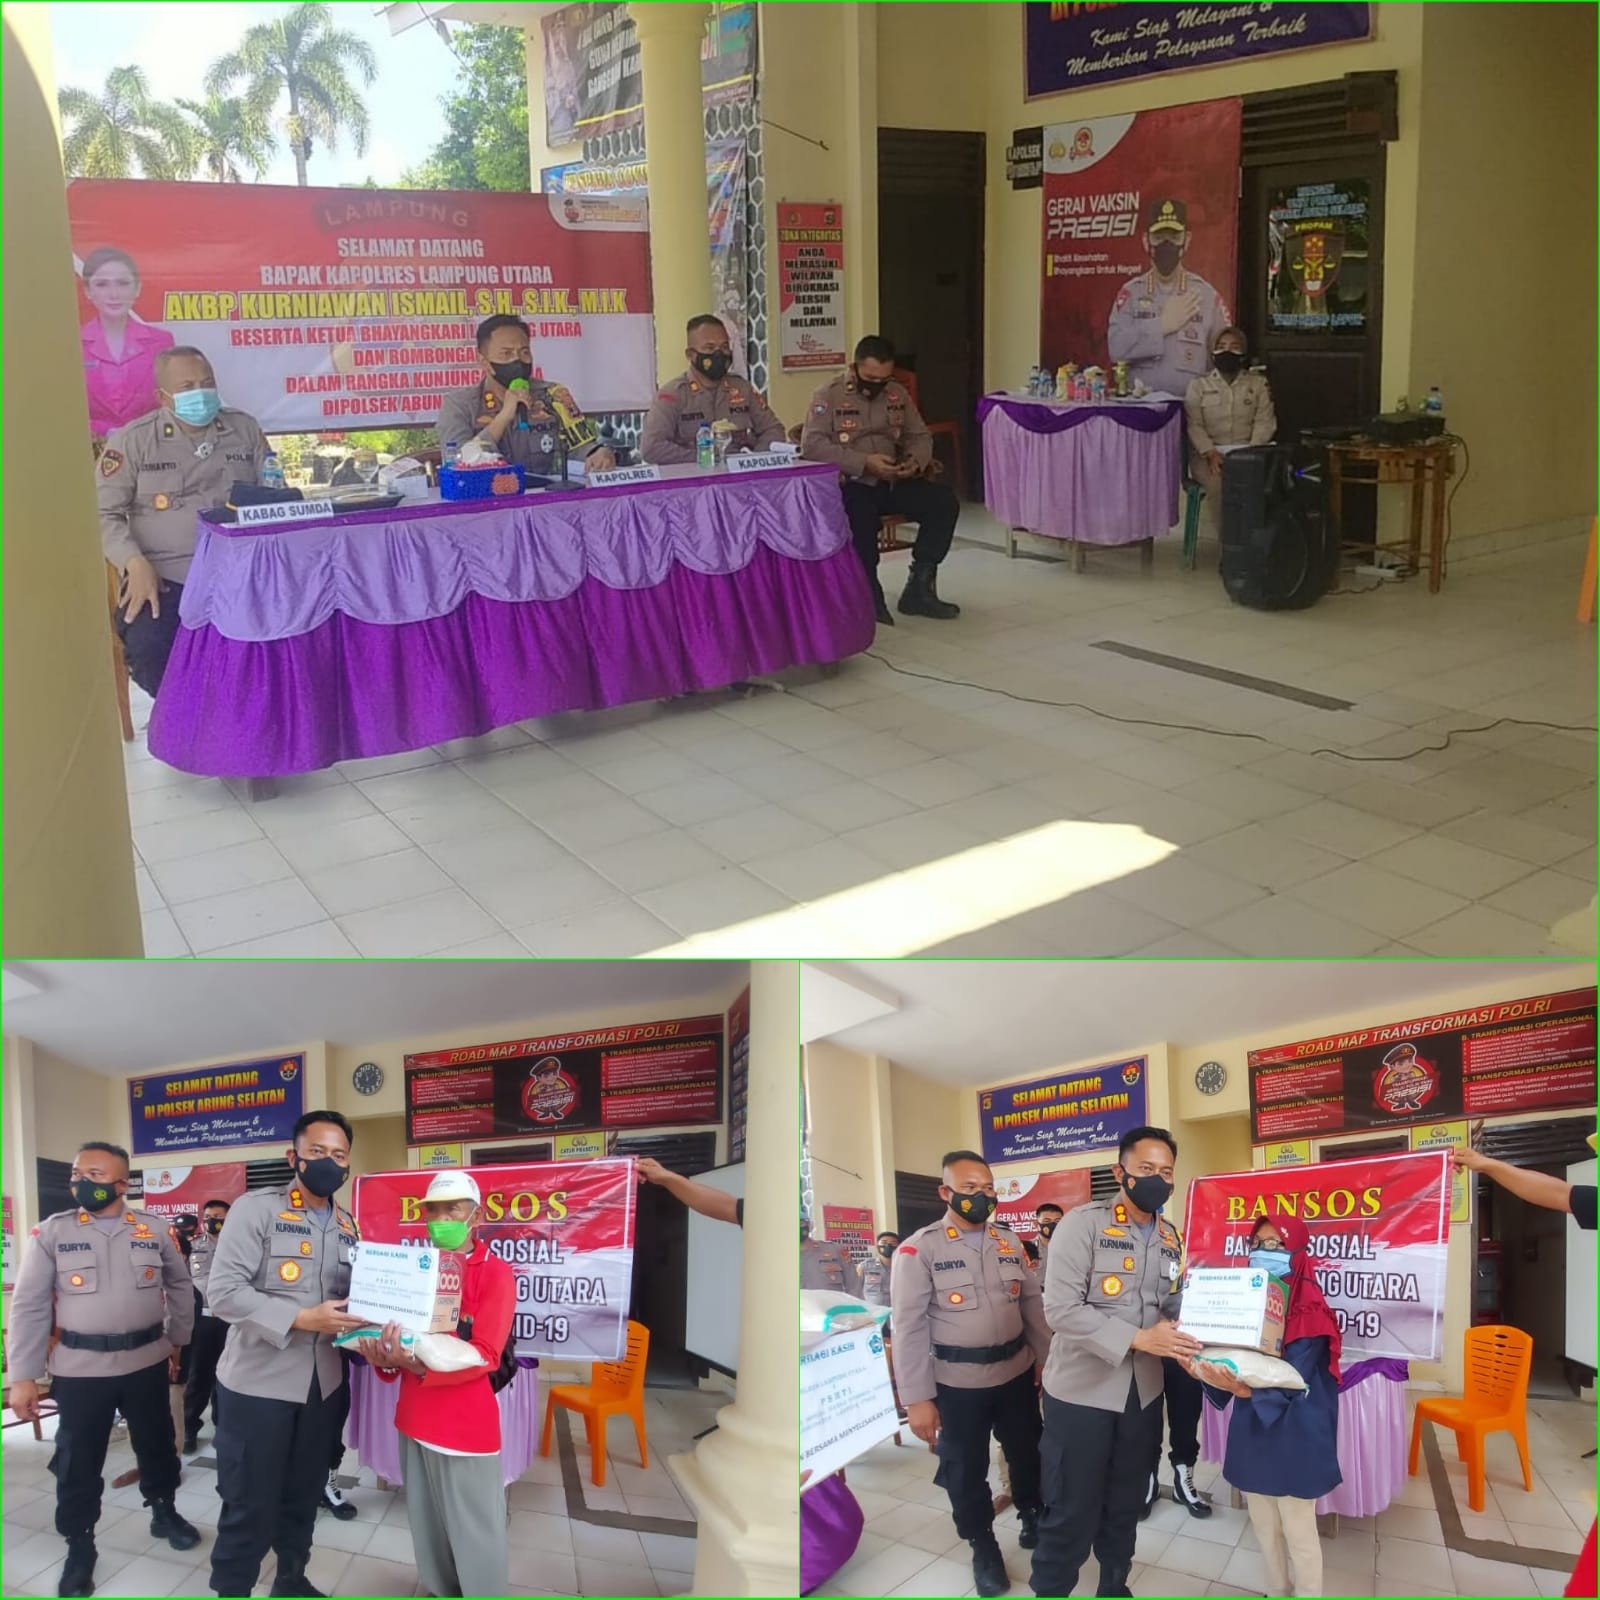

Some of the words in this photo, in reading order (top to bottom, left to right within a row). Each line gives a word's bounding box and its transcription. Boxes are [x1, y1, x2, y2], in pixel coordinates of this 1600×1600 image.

[1090, 27, 1128, 49] Kami
[1134, 19, 1169, 39] Siap
[1176, 3, 1253, 29] Melayani
[1066, 50, 1148, 76] Memberikan
[1153, 33, 1236, 58] Pelayanan
[1243, 13, 1307, 42] Terbaik
[325, 200, 469, 228] LAMPUNG
[1047, 197, 1085, 216] GERAI
[1089, 192, 1140, 212] VAKSIN
[1047, 213, 1138, 240] PRESISI
[1295, 221, 1334, 233] PROPAM
[338, 238, 415, 258] SELAMAT
[420, 239, 484, 257] DATANG
[798, 248, 825, 257] ANDA
[785, 259, 838, 269] MEMASUKI
[261, 266, 321, 285] BAPAK
[327, 266, 415, 285] KAPOLRES
[420, 266, 498, 284] LAMPUNG
[503, 266, 552, 284] UTARA
[790, 271, 834, 280] WILAYAH
[785, 282, 839, 293] BIROKRASI
[165, 292, 237, 321] AKBP
[240, 291, 386, 320] KURNIAWAN
[391, 290, 472, 317] ISMAIL,
[795, 294, 831, 304] BERSIH
[803, 306, 823, 316] DAN
[790, 317, 837, 328] MELAYANI
[231, 327, 303, 346] BESERTA
[307, 327, 355, 344] KETUA
[361, 323, 466, 343] BHAYANGKARI
[540, 322, 581, 337] UTARA
[354, 349, 384, 366] DAN
[389, 346, 478, 365] ROMBONGA
[286, 375, 341, 393] DALAM
[346, 372, 409, 391] RANGKA
[413, 370, 487, 388] KUNJUNGA
[323, 397, 398, 415] DIPOLSEK
[402, 394, 442, 412] ABUN
[738, 455, 791, 469] KAPOLSEK
[596, 469, 655, 483] KAPOLRES
[242, 504, 285, 522] KABAG
[288, 501, 332, 517] SUMDA
[1295, 1039, 1335, 1057] ROAD
[1336, 1032, 1369, 1049] MAP
[1372, 1010, 1495, 1042] TRANSFORMASI
[1498, 999, 1553, 1020] POLRI
[450, 1049, 486, 1062] ROAD
[488, 1044, 518, 1058] MAP
[521, 1030, 631, 1053] TRANSFORMASI
[634, 1023, 680, 1039] POLRI
[166, 1077, 213, 1097] SELAMAT
[214, 1070, 259, 1089] DATANG
[1012, 1084, 1058, 1107] SELAMAT
[1059, 1076, 1102, 1097] DATANG
[1383, 1083, 1432, 1102] PRESISI
[144, 1105, 156, 1120] DI
[157, 1100, 195, 1119] POLSEK
[237, 1088, 286, 1109] SELATAN
[992, 1116, 1004, 1131] DI
[1004, 1108, 1041, 1128] POLSEK
[1080, 1093, 1129, 1115] SELATAN
[154, 1136, 198, 1147] Memberikan
[201, 1131, 241, 1144] Pelayanan
[245, 1125, 276, 1138] Terbaik
[1002, 1146, 1044, 1157] Memberikan
[1047, 1140, 1086, 1152] Pelayanan
[1089, 1132, 1120, 1143] Terbaik
[147, 1204, 172, 1215] GERAI
[173, 1202, 199, 1213] VAKSIN
[399, 1190, 569, 1222] BSOS
[1225, 1187, 1383, 1221] BANSOS
[996, 1212, 1019, 1222] GERAI
[275, 1222, 312, 1237] KURNIAWAN
[58, 1242, 92, 1252] SURYA
[131, 1241, 160, 1250] POLRI
[491, 1237, 565, 1266] SOSIAL
[1099, 1238, 1135, 1251] KURNIAWAN
[1307, 1234, 1377, 1260] SOSIAL
[934, 1260, 967, 1271] SURYA
[532, 1274, 607, 1306] UTARA
[1344, 1272, 1421, 1303] UTARA
[831, 1340, 856, 1356] KASIH
[806, 1437, 839, 1458] BERSAMA
